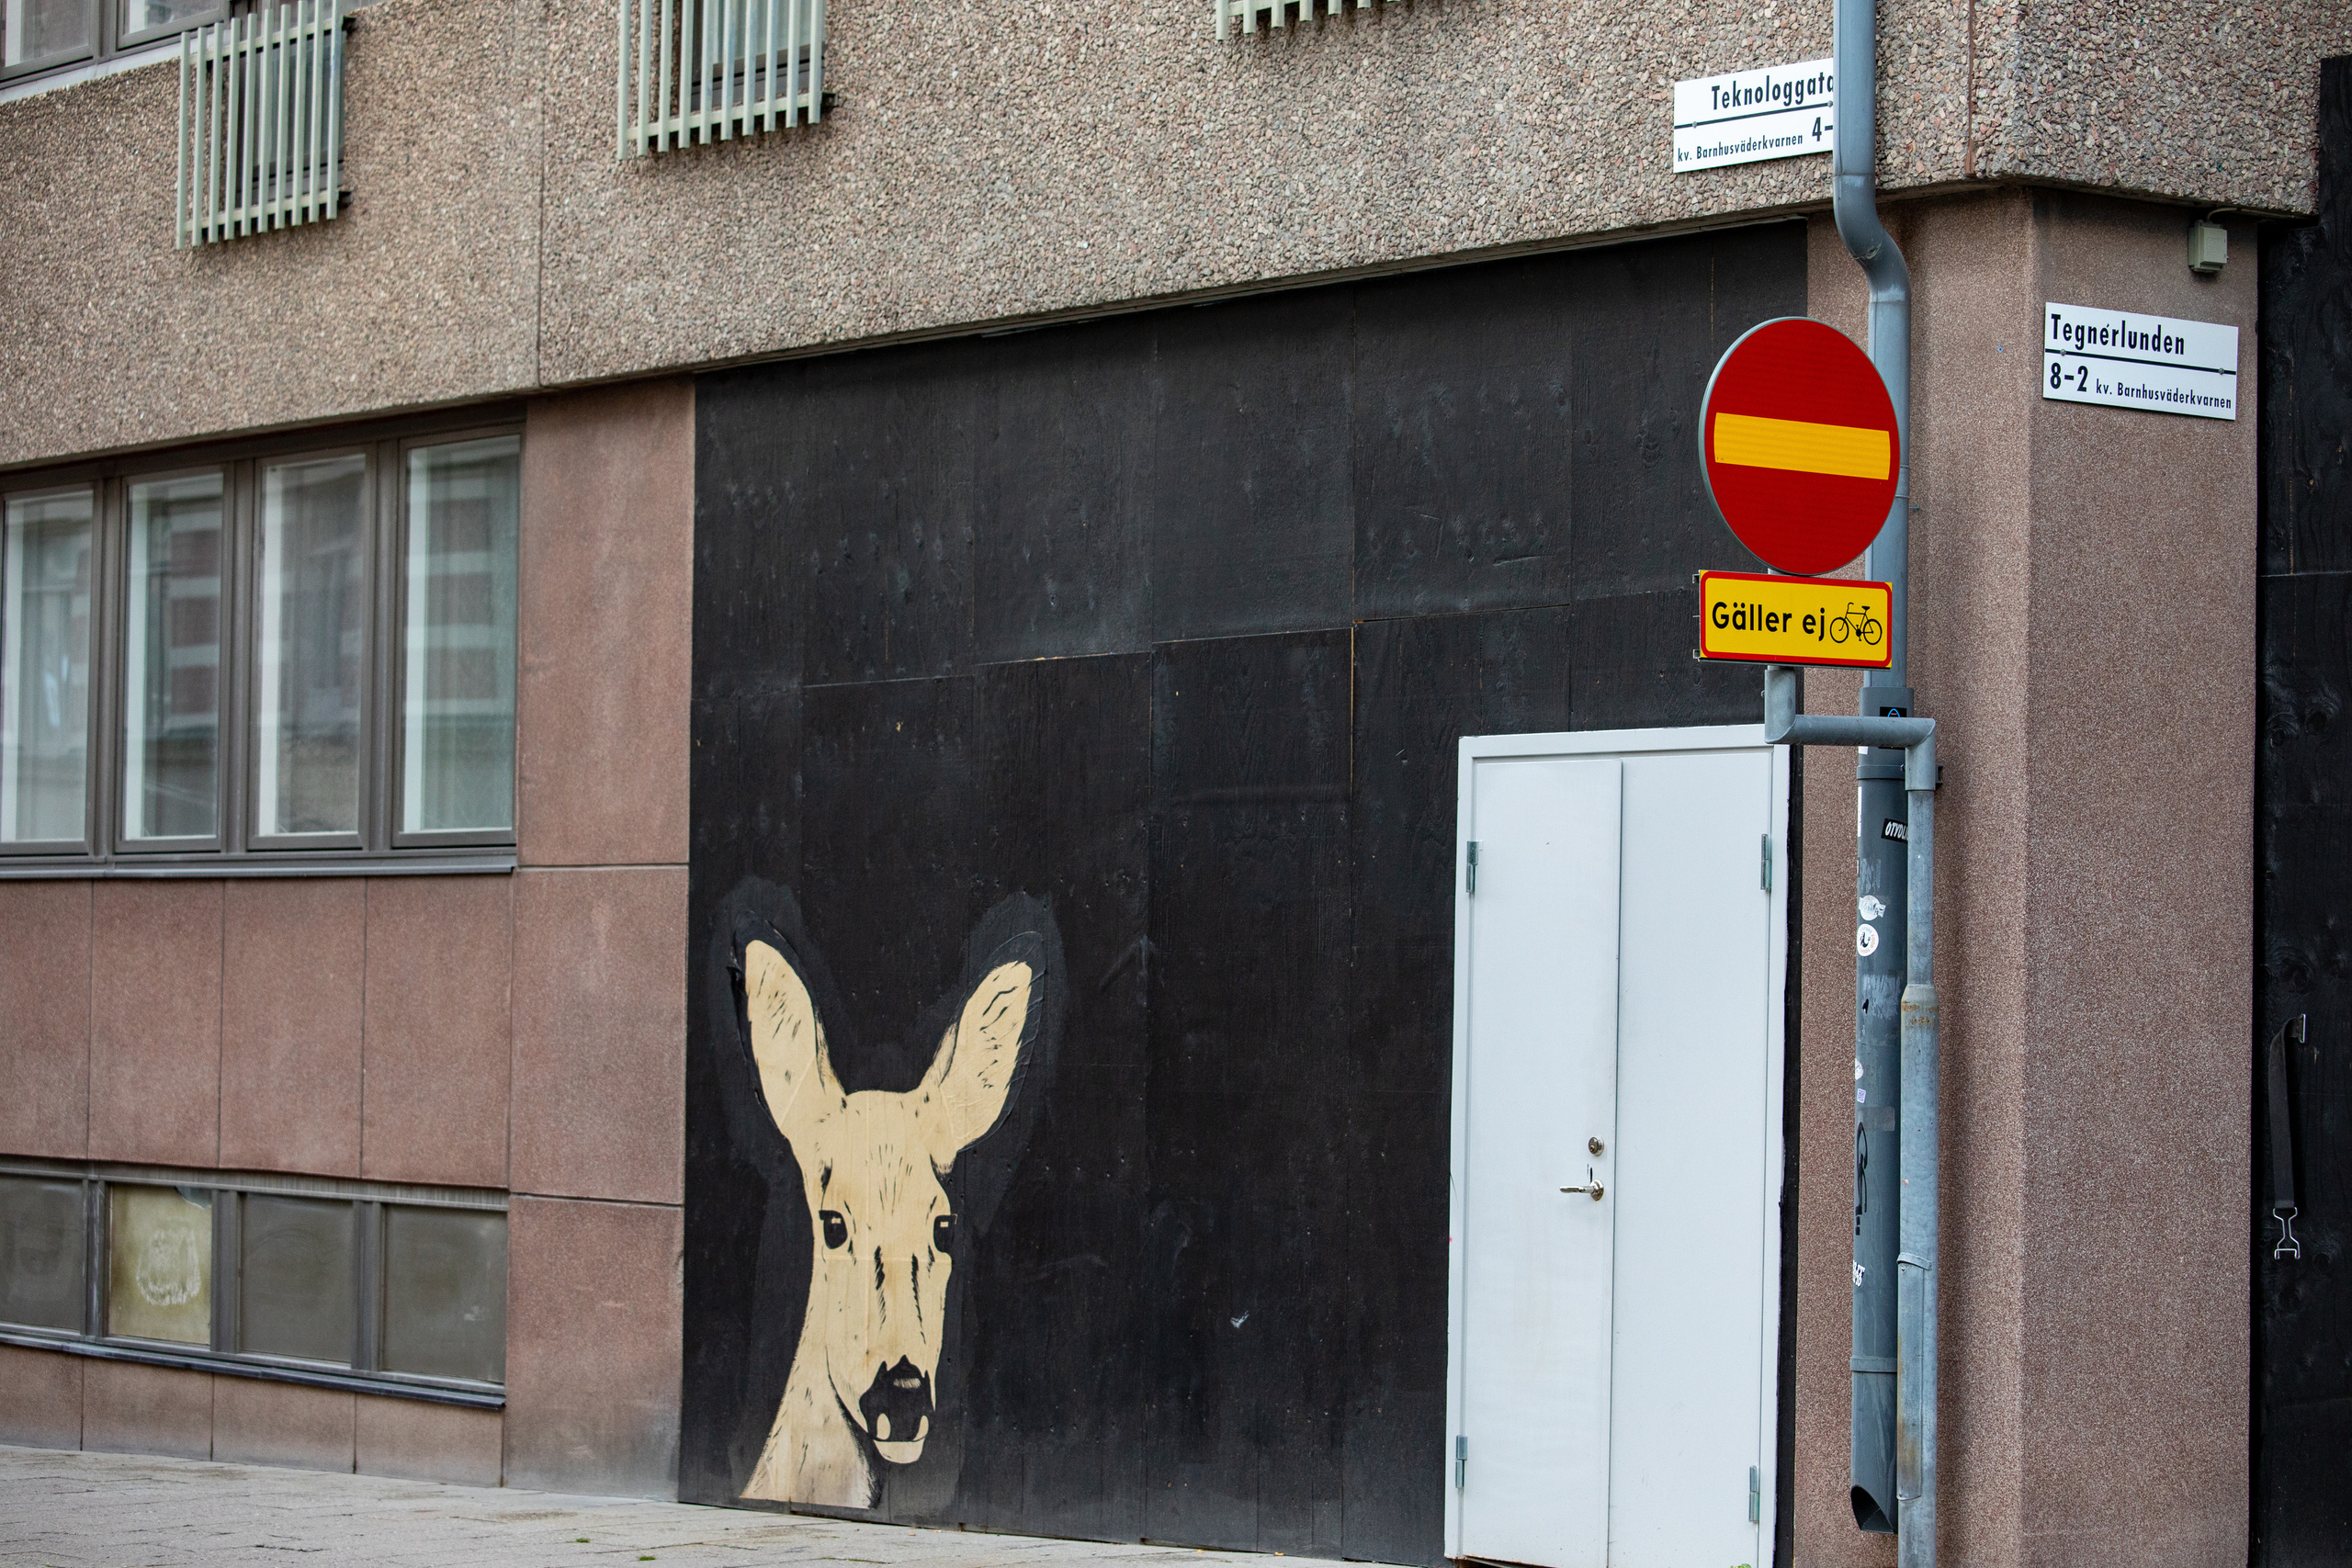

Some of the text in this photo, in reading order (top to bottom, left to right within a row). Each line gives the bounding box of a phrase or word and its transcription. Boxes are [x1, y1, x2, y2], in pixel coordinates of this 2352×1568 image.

[1678, 148, 1692, 162] kv.
[1696, 134, 1803, 160] Barnhusväderkvarnen
[2051, 313, 2185, 355] Tegnérlunden
[2050, 362, 2232, 409] 8-2 kv. Barnhusväderkvarnen
[1712, 602, 1826, 642] Gäller ej
